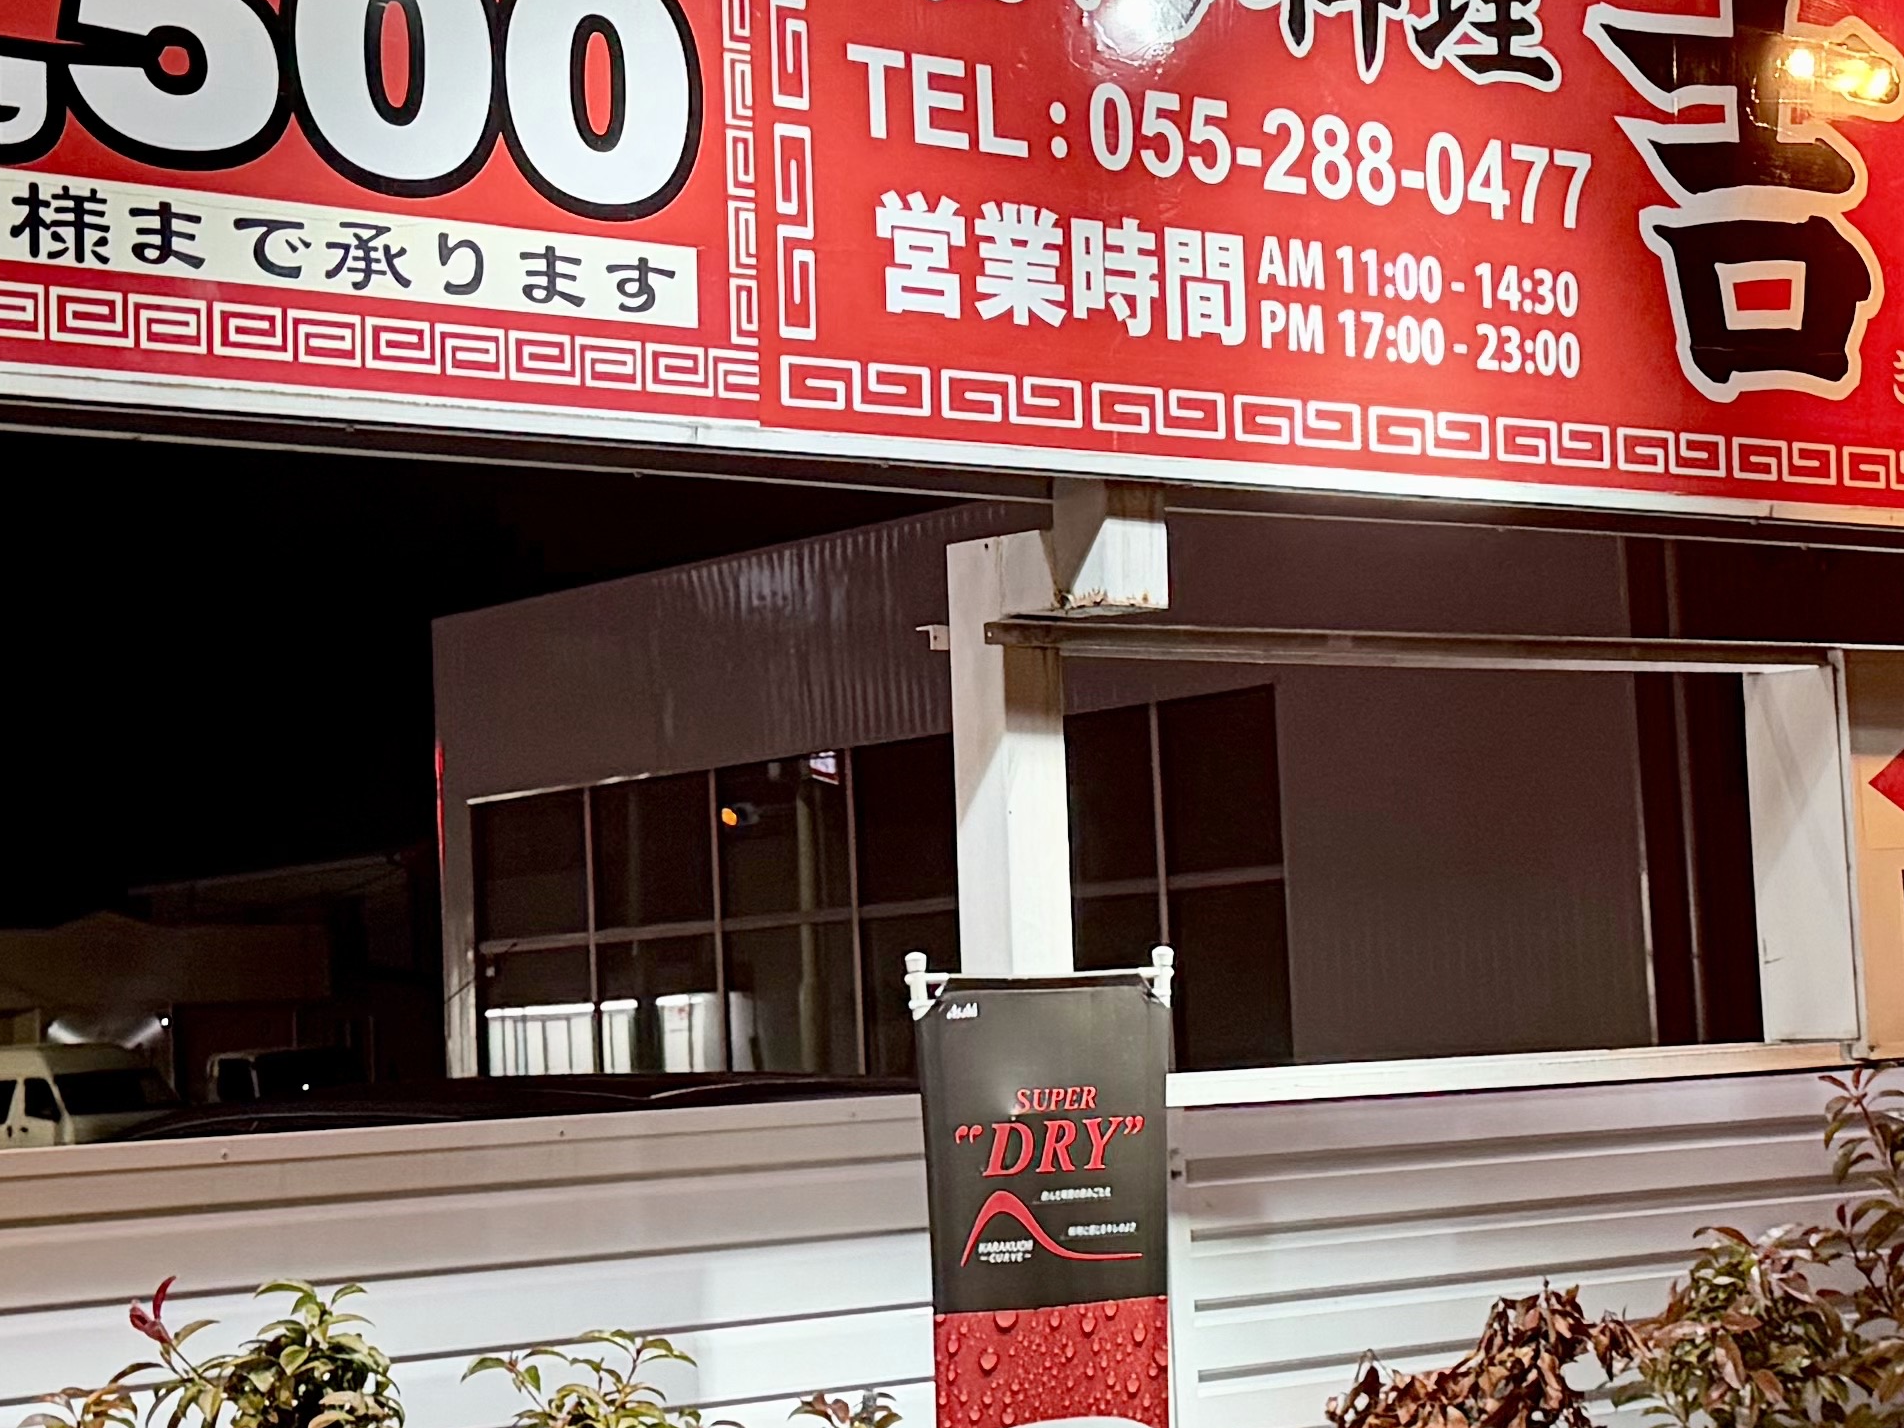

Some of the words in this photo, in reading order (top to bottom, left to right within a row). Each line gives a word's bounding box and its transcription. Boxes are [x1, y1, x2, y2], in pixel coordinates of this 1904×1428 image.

[1089, 83, 1593, 231] 055-288-0477
[873, 189, 1248, 348] 営業時間
[1258, 236, 1325, 292] AM
[1336, 244, 1445, 307] 11:00
[1474, 257, 1579, 318] 14:30
[1260, 298, 1325, 355] PM
[1338, 308, 1446, 369] 17:00
[1474, 320, 1581, 380] 23:00
[1013, 1087, 1096, 1113] SUPER
